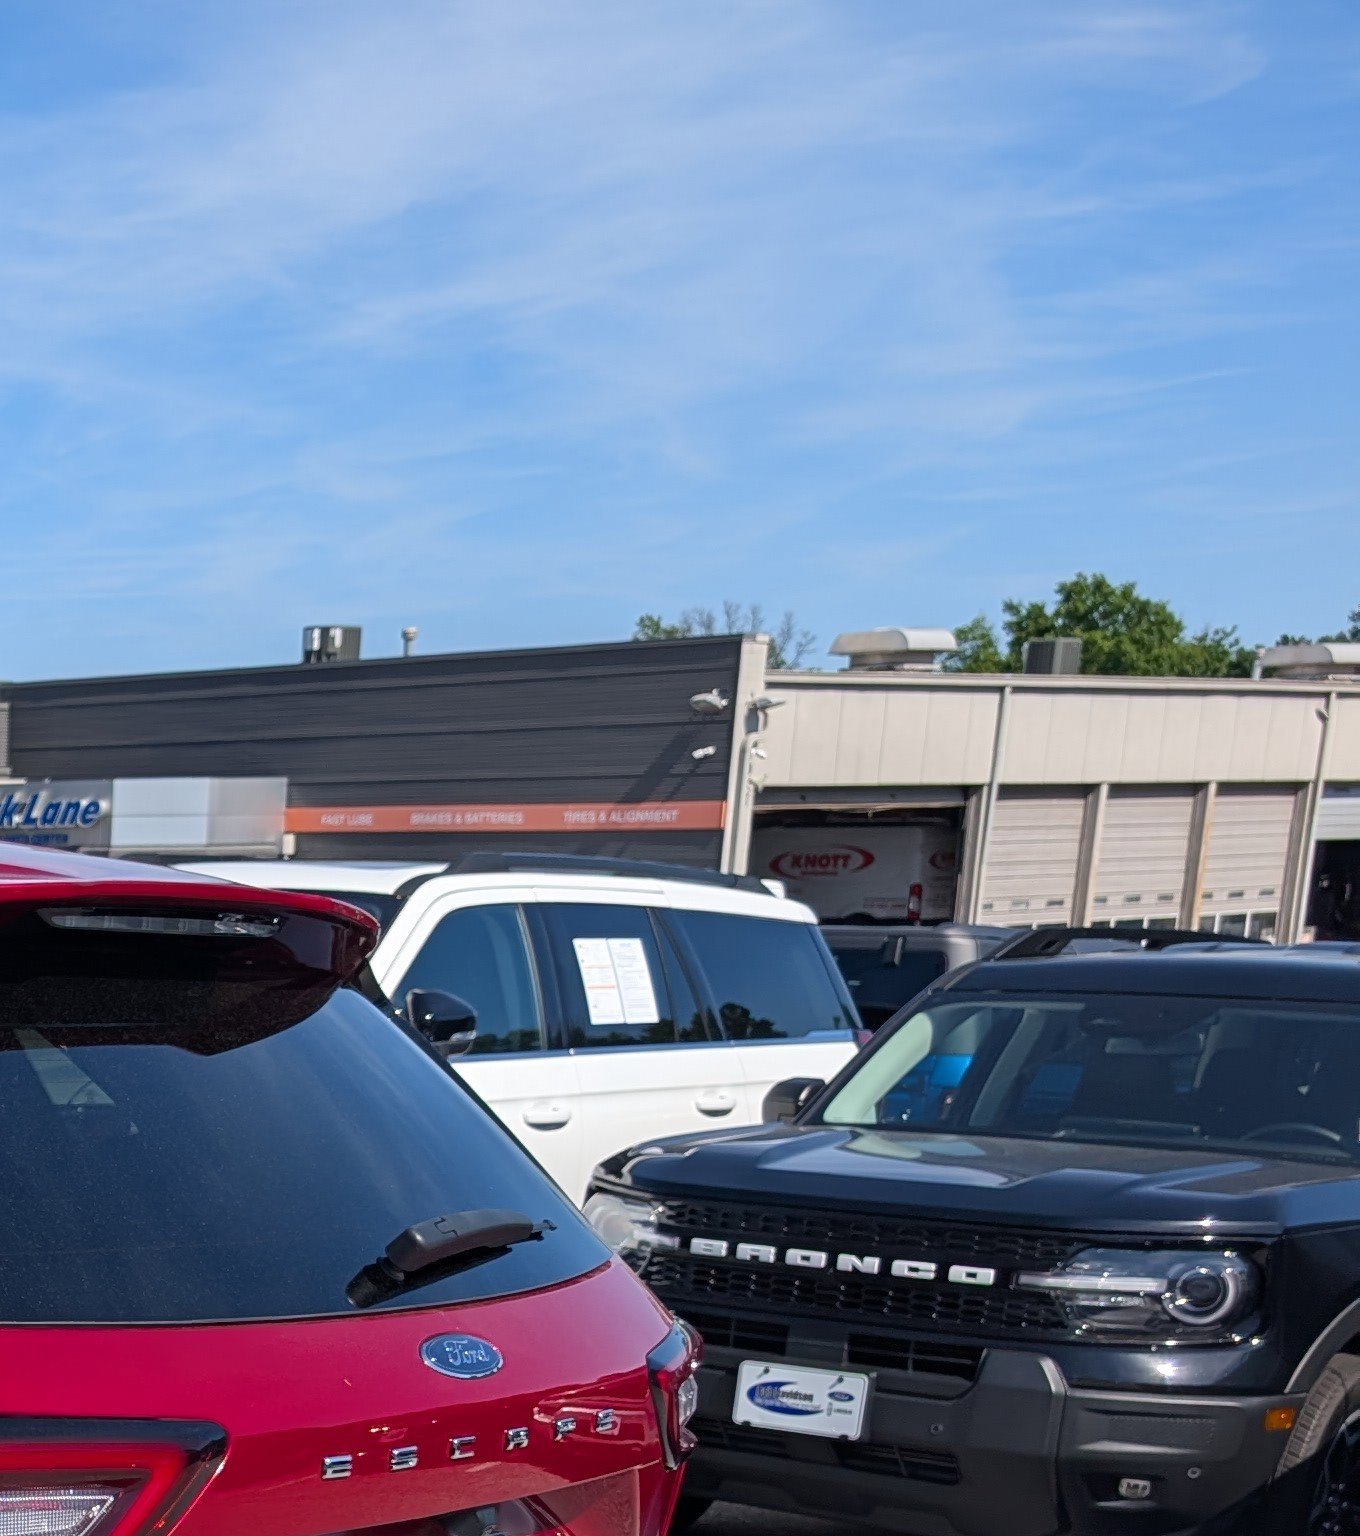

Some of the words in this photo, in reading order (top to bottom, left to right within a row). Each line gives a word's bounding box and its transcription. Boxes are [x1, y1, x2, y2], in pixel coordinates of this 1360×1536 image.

[320, 813, 345, 826] FAST
[347, 813, 373, 826] LUBE
[410, 812, 453, 825] BRAKES
[453, 813, 462, 825] &
[464, 811, 524, 825] BATTERIES
[563, 810, 596, 824] TIRES
[597, 810, 608, 823] &
[609, 809, 679, 823] ALIGNMENT
[791, 853, 852, 869] KNOTT
[689, 1237, 996, 1286] BRONCO
[444, 1340, 490, 1366] Ford
[322, 1408, 617, 1480] ESCAPE
